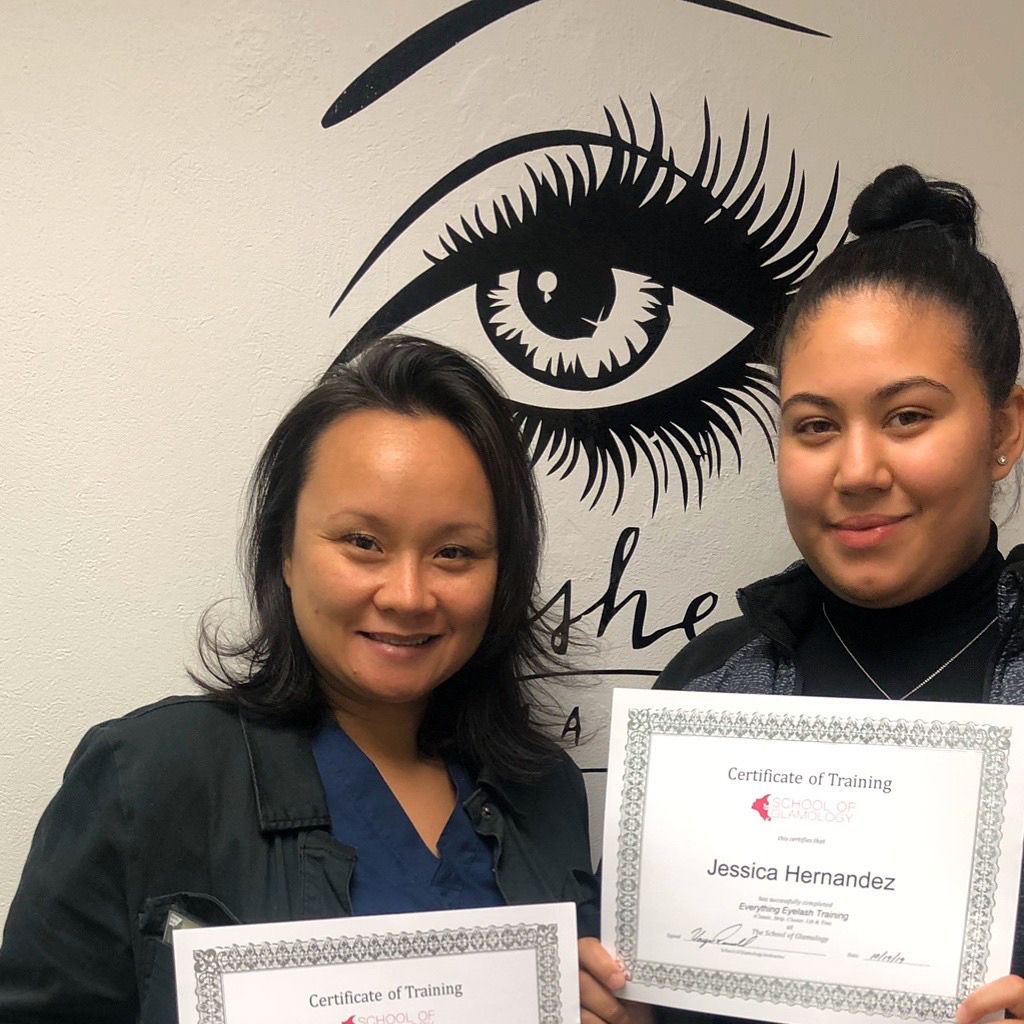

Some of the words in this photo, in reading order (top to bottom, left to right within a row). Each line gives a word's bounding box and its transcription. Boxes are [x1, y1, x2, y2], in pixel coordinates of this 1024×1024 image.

[728, 766, 804, 785] Certificate
[808, 772, 826, 786] of
[828, 772, 893, 794] Training
[772, 796, 832, 811] SCHOOL
[836, 801, 857, 813] OF
[771, 808, 854, 824] GLAMOLOGY
[707, 858, 778, 881] Jessica
[785, 865, 896, 891] Hernandez
[738, 902, 780, 915] Everything
[782, 906, 814, 918] Eyelash
[816, 908, 850, 922] Training
[752, 928, 764, 936] The
[764, 928, 786, 940] School
[786, 931, 795, 941] of
[795, 932, 830, 944] Glamology
[309, 990, 382, 1008] Certificate
[388, 986, 404, 1001] of
[404, 982, 464, 1000] Training
[417, 1009, 436, 1023] OF
